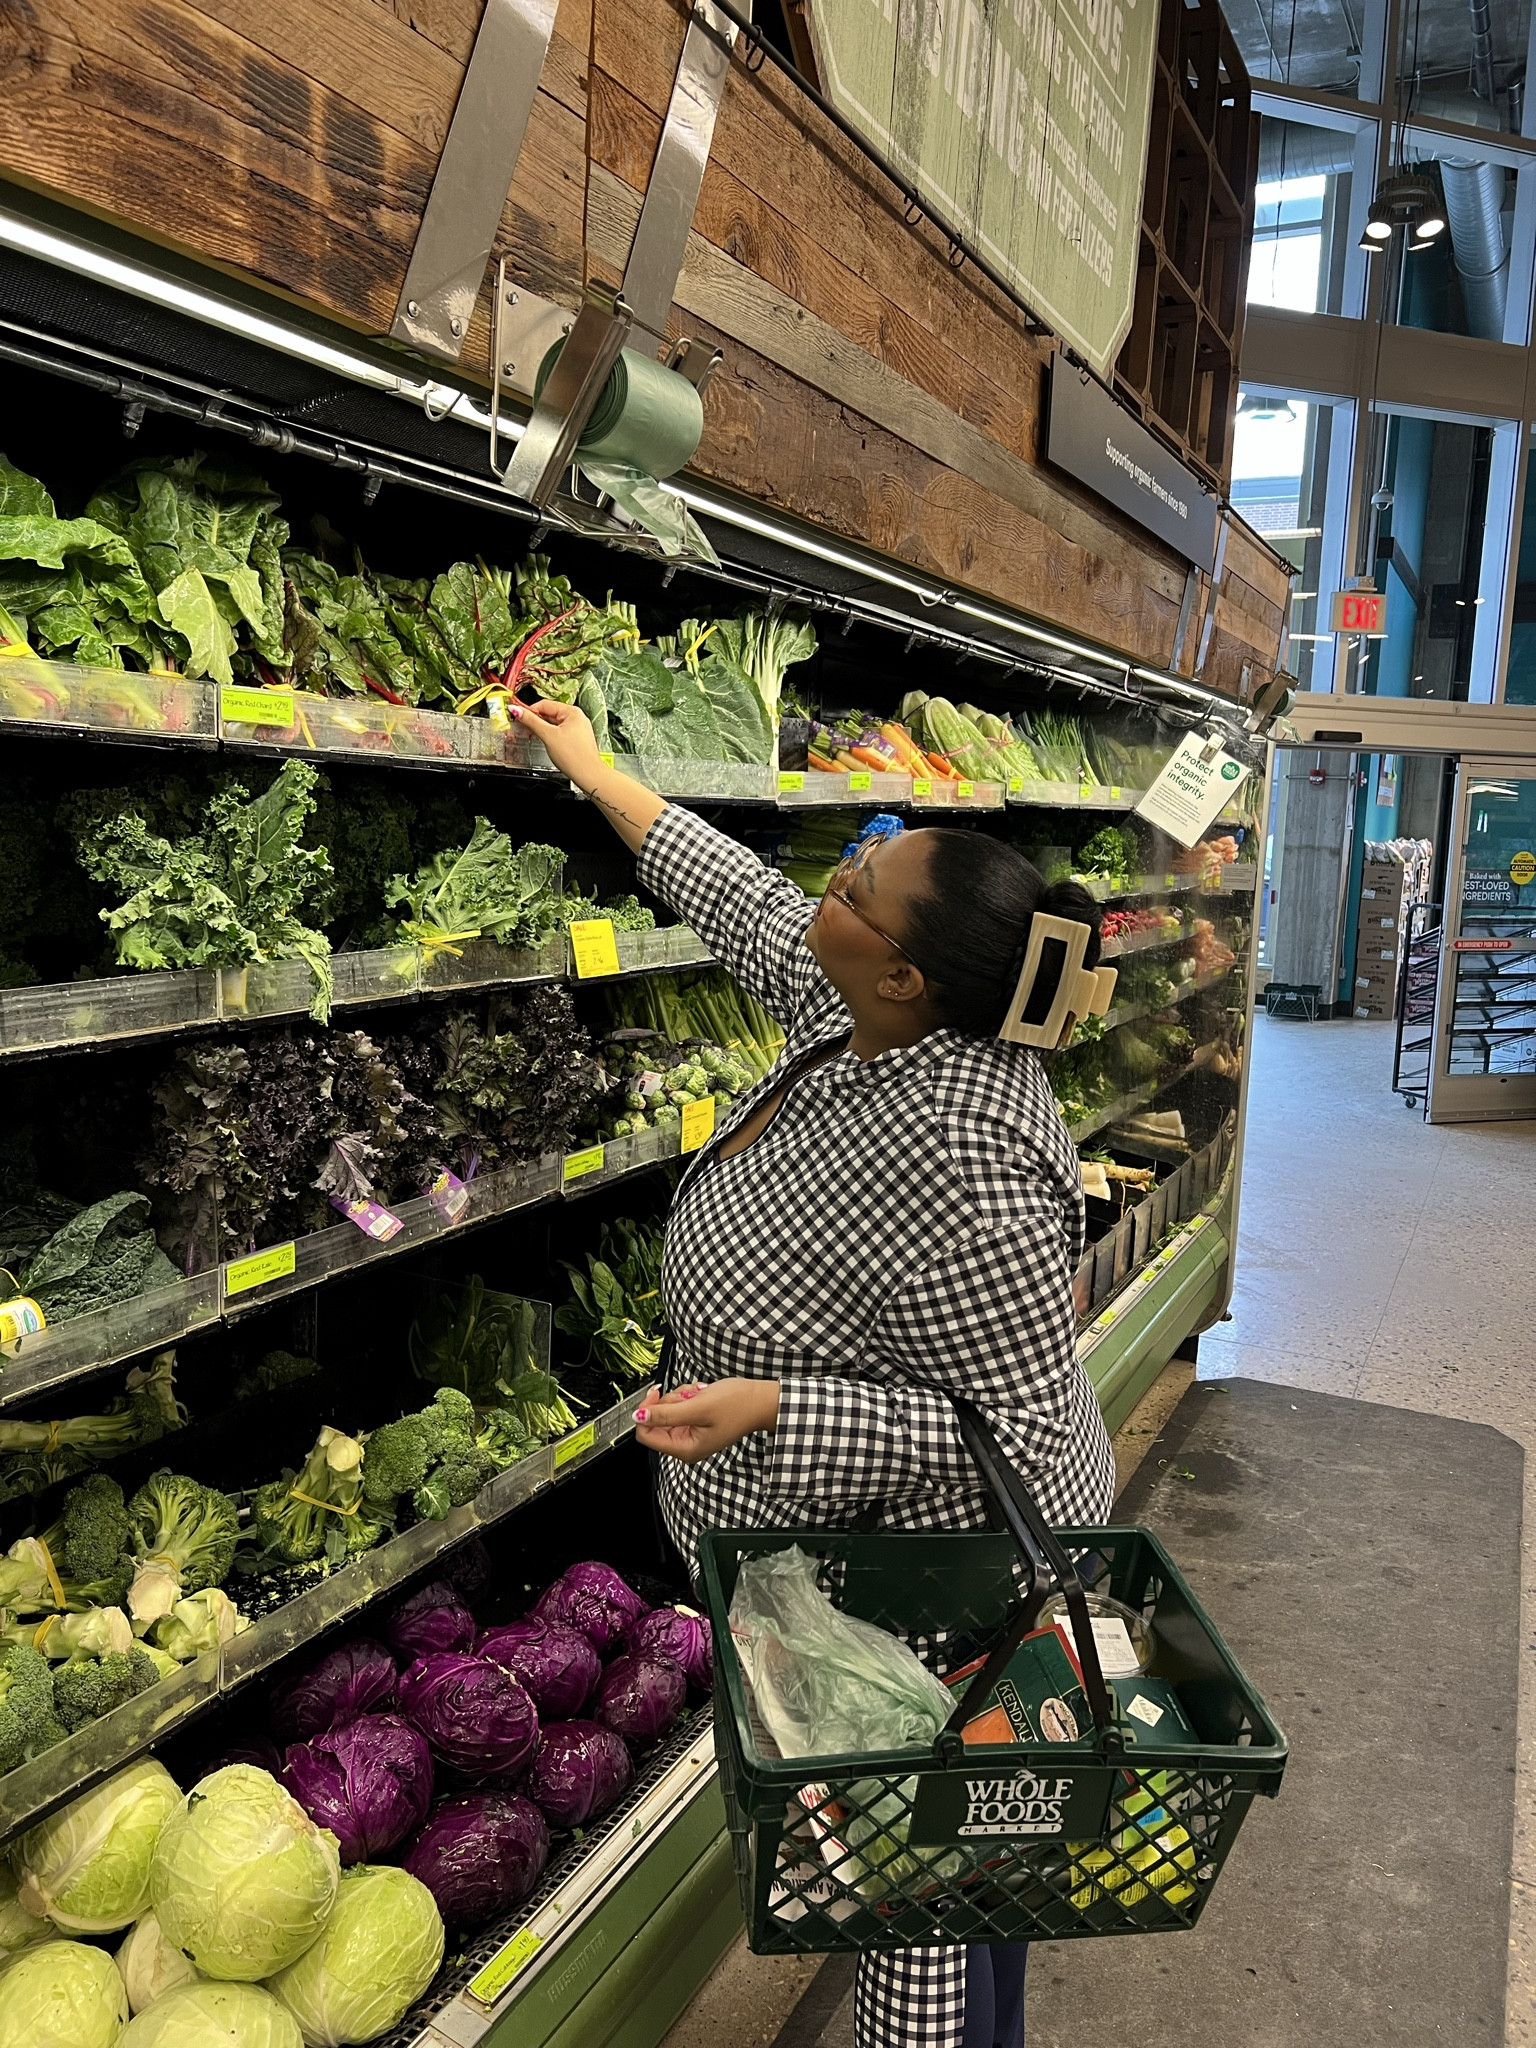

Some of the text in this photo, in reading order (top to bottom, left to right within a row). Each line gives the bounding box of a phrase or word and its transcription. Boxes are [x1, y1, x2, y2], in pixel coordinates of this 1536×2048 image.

[1066, 46, 1090, 123] THE
[1089, 86, 1125, 176] EARTH
[1032, 96, 1118, 232] PESTICIDES, HERBICIDES
[1026, 143, 1114, 288] AND FERTILIZERS
[1105, 437, 1188, 519] Supporting organic farmers since 1980
[1343, 595, 1380, 629] EXIT
[223, 697, 272, 709] Organic Red Chard
[1174, 761, 1208, 787] organic
[1180, 749, 1214, 777] Protect
[1166, 769, 1205, 801] integrity.
[1463, 880, 1510, 891] EST-LOVED
[1469, 872, 1502, 880] Baked with
[965, 1776, 1074, 1802] WHOLE
[964, 1800, 1063, 1824] FOODS
[964, 1824, 1057, 1834] MARKET
